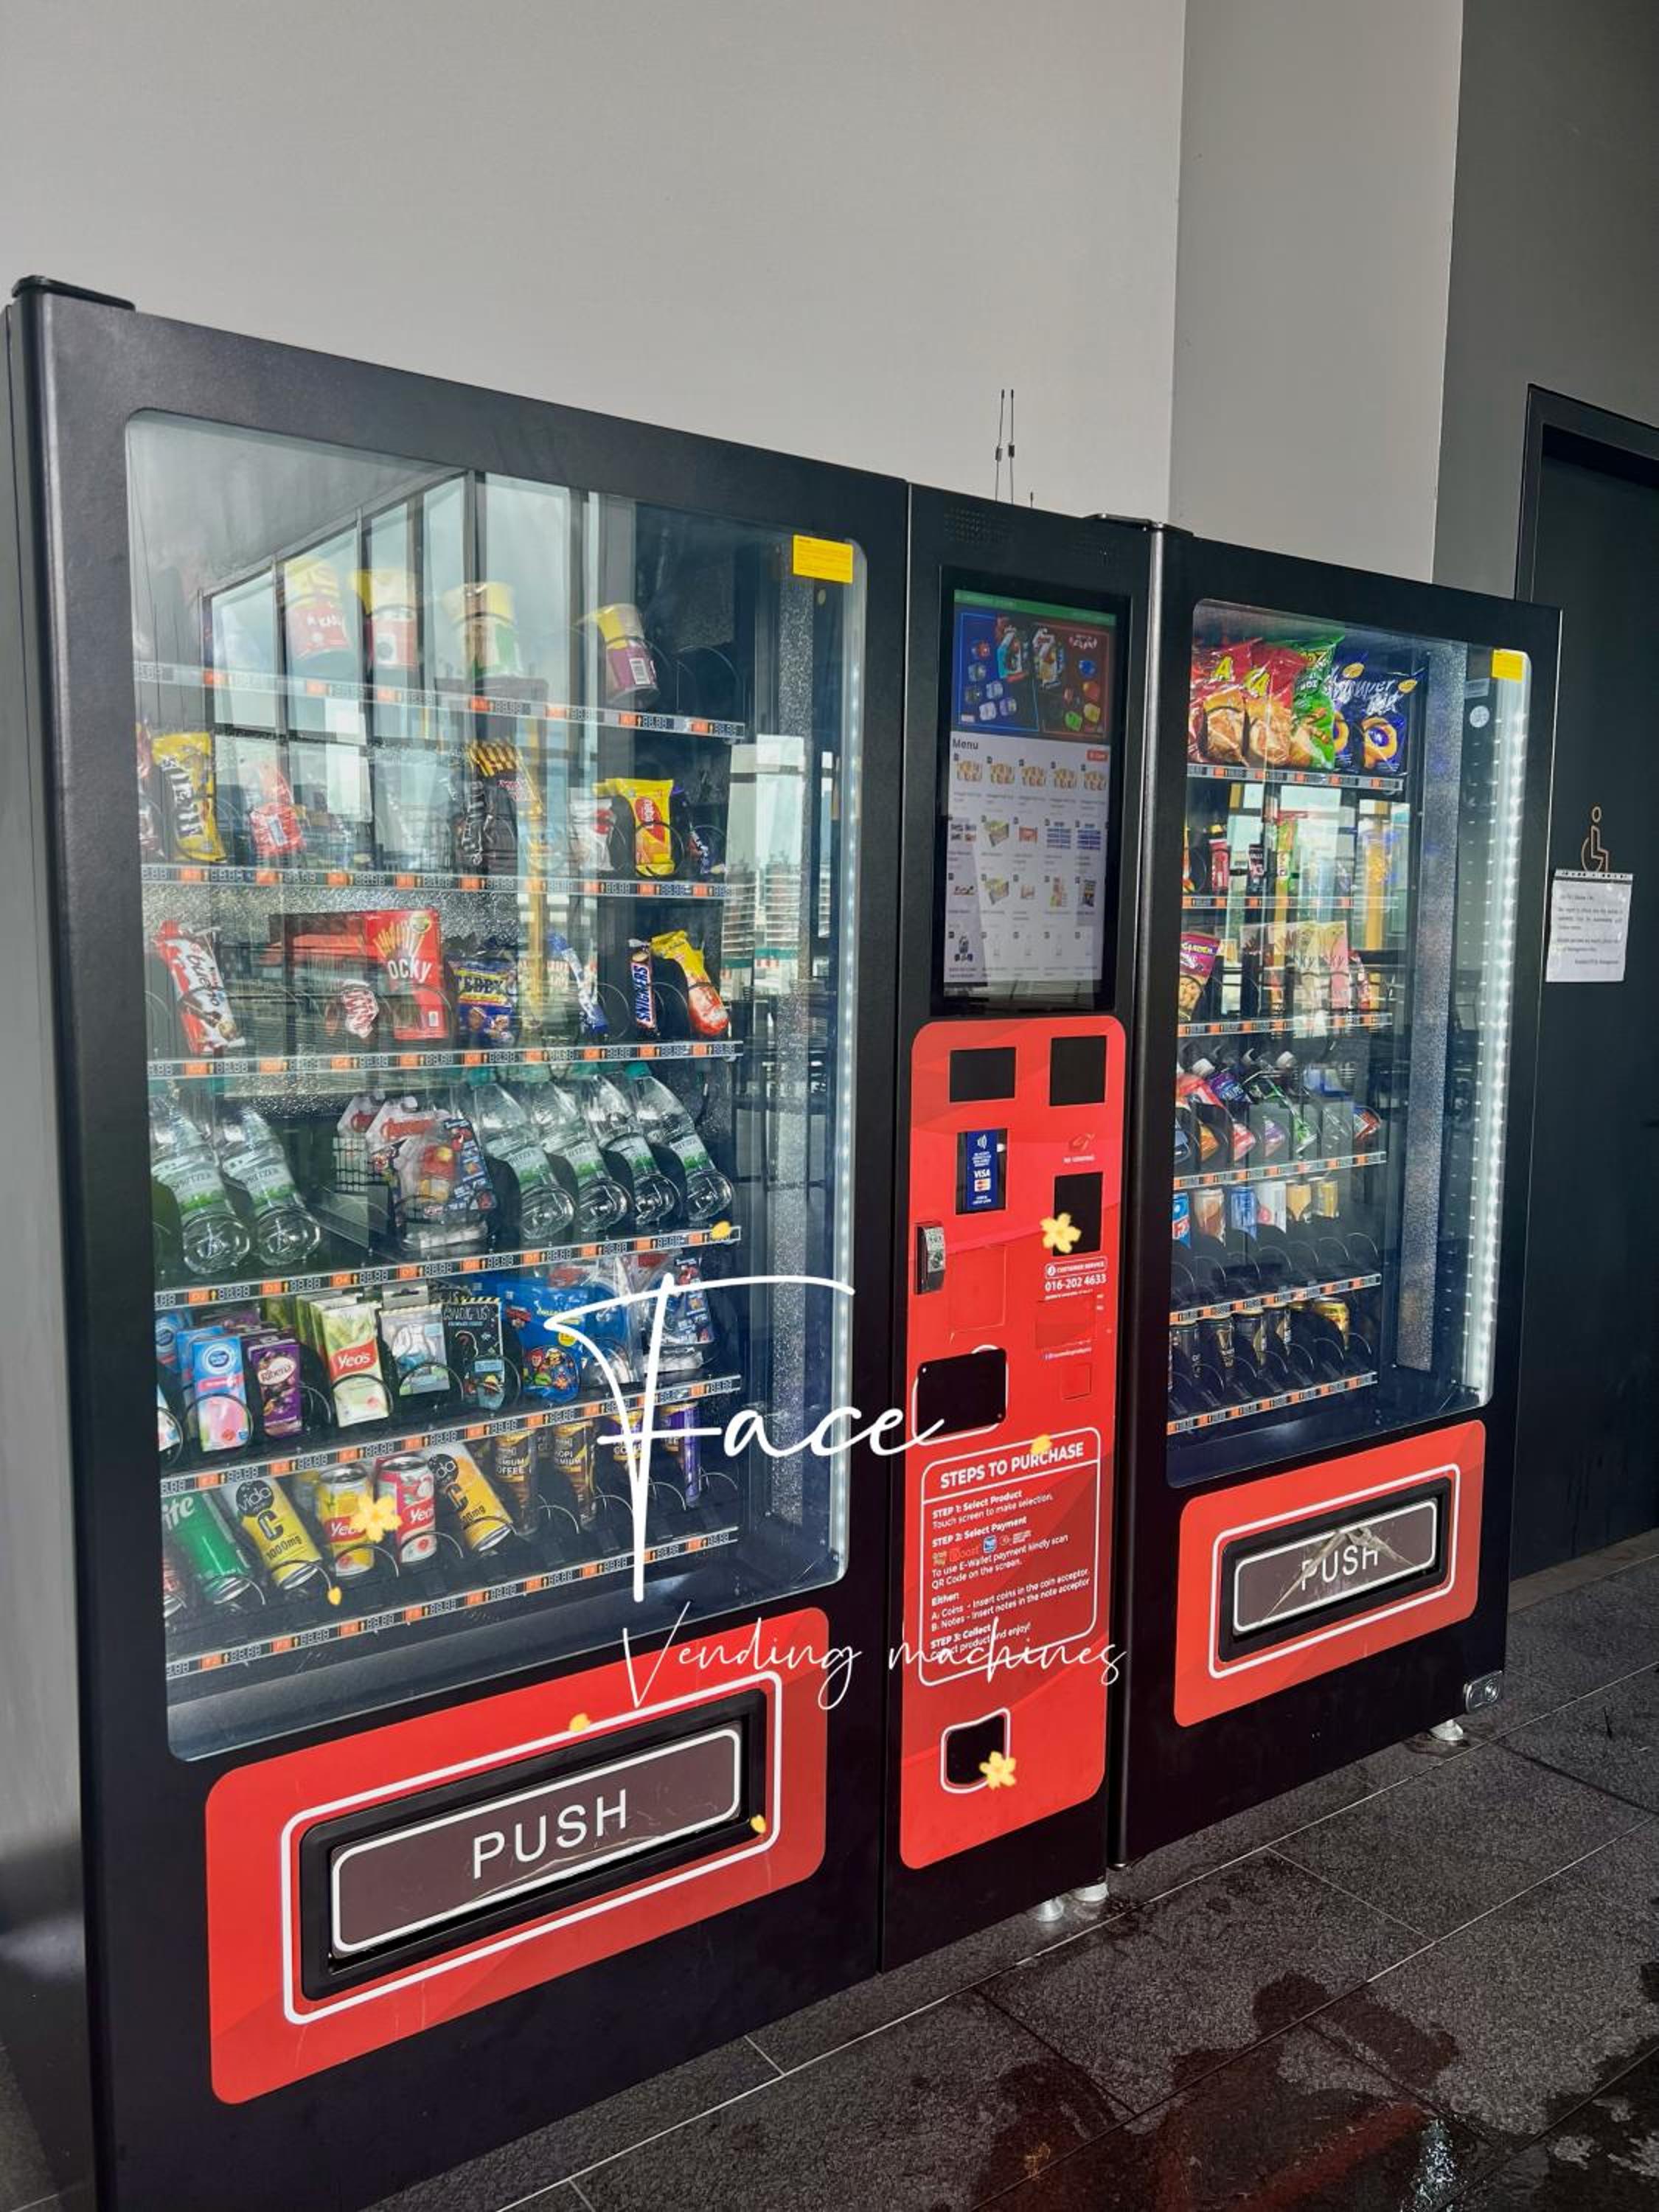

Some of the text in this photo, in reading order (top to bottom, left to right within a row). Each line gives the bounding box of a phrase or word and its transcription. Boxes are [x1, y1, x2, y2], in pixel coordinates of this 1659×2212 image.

[952, 739, 979, 750] Menu
[633, 964, 653, 1022] SNICKERS
[973, 1169, 990, 1178] VISA
[1045, 1273, 1107, 1292] 016-202 4633
[940, 1442, 1084, 1489] STEPS TO PURCHASE
[932, 1506, 954, 1519] STEP
[963, 1496, 989, 1512] Select
[990, 1490, 1022, 1504] Product
[932, 1517, 956, 1528] Touch
[959, 1512, 984, 1523] screen
[987, 1508, 994, 1516] to
[995, 1502, 1017, 1514] make
[932, 1533, 954, 1547] STEP
[964, 1526, 990, 1540] Select
[991, 1516, 1027, 1534] Payment
[265, 1534, 303, 1560] 1000mg
[932, 1569, 942, 1578] To
[944, 1565, 957, 1575] use
[959, 1556, 992, 1571] E-Wallet
[993, 1545, 1027, 1562] payment
[1029, 1540, 1051, 1555] kindly
[1051, 1534, 1068, 1545] scan
[932, 1579, 945, 1590] QR
[946, 1573, 967, 1585] Code
[968, 1570, 979, 1579] on
[981, 1565, 993, 1576] the
[1301, 1545, 1379, 1590] PUSH
[942, 1605, 963, 1617] Coins
[973, 1597, 995, 1608] Insert
[996, 1590, 1017, 1601] coins
[1018, 1587, 1025, 1595] in
[1026, 1582, 1039, 1592] the
[1040, 1578, 1056, 1588] coin
[942, 1615, 964, 1629] Notes
[995, 1601, 1017, 1613] notes
[1018, 1597, 1026, 1606] in
[1026, 1593, 1039, 1602] the
[1040, 1587, 1057, 1599] note
[931, 1635, 952, 1649] STEP
[962, 1624, 992, 1638] Collect
[960, 1638, 991, 1654] product
[472, 1788, 627, 1879] PUSH
